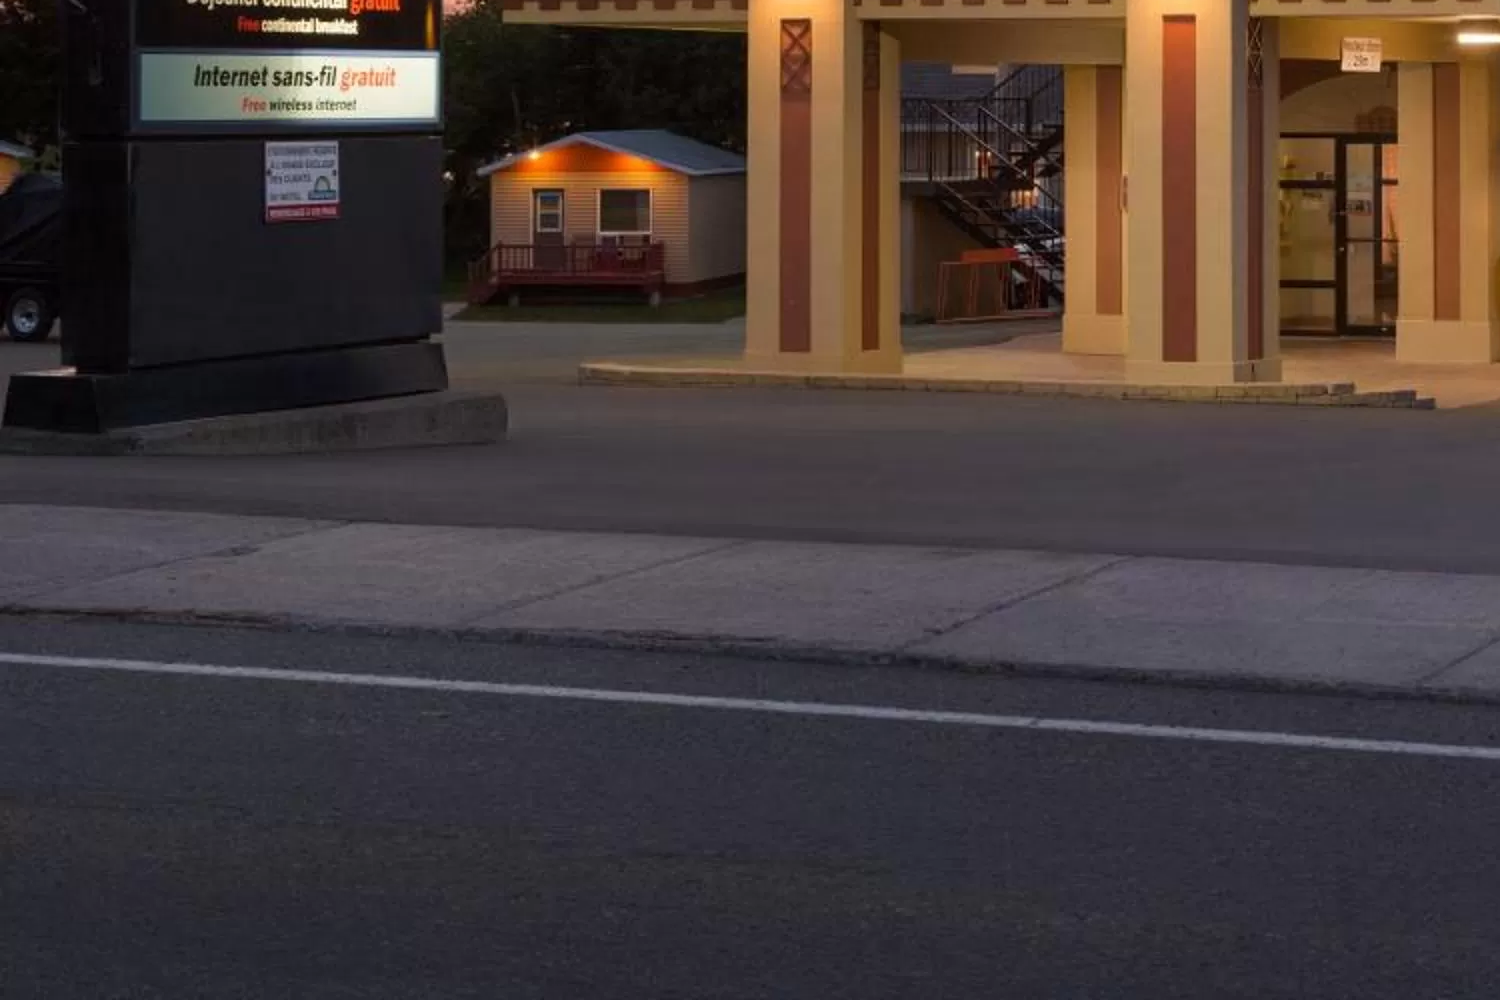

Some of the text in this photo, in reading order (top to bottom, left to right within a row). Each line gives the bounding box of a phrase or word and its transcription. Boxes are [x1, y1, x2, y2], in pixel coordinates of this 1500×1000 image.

[194, 63, 397, 91] Internet sans-fil gratuit
[242, 97, 267, 113] Free
[269, 98, 313, 112] wireless
